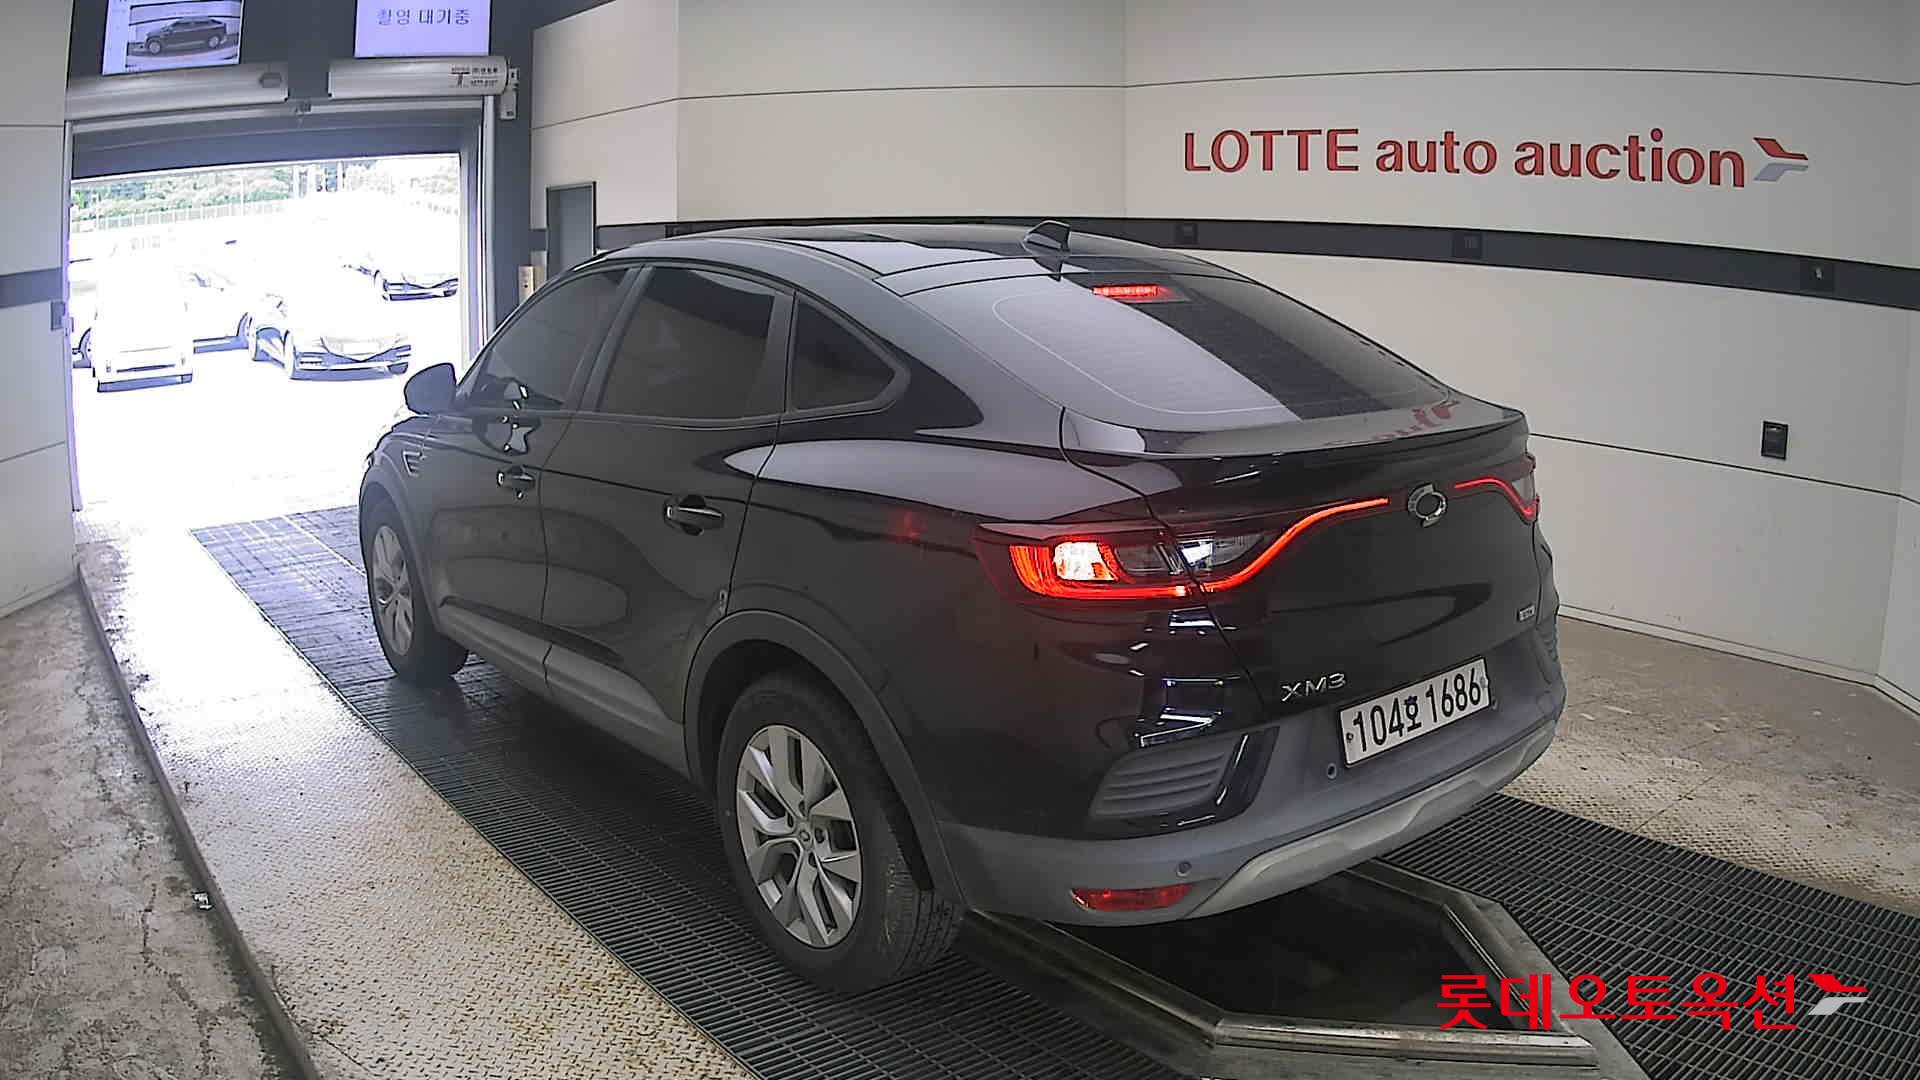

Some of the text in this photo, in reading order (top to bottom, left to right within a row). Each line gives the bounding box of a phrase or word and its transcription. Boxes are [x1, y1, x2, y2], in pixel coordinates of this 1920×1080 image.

[418, 8, 472, 25] 대기중
[1184, 127, 1746, 188] LOTTE auto auction
[1281, 672, 1346, 701] XM3
[1353, 667, 1481, 752] 104호 1686
